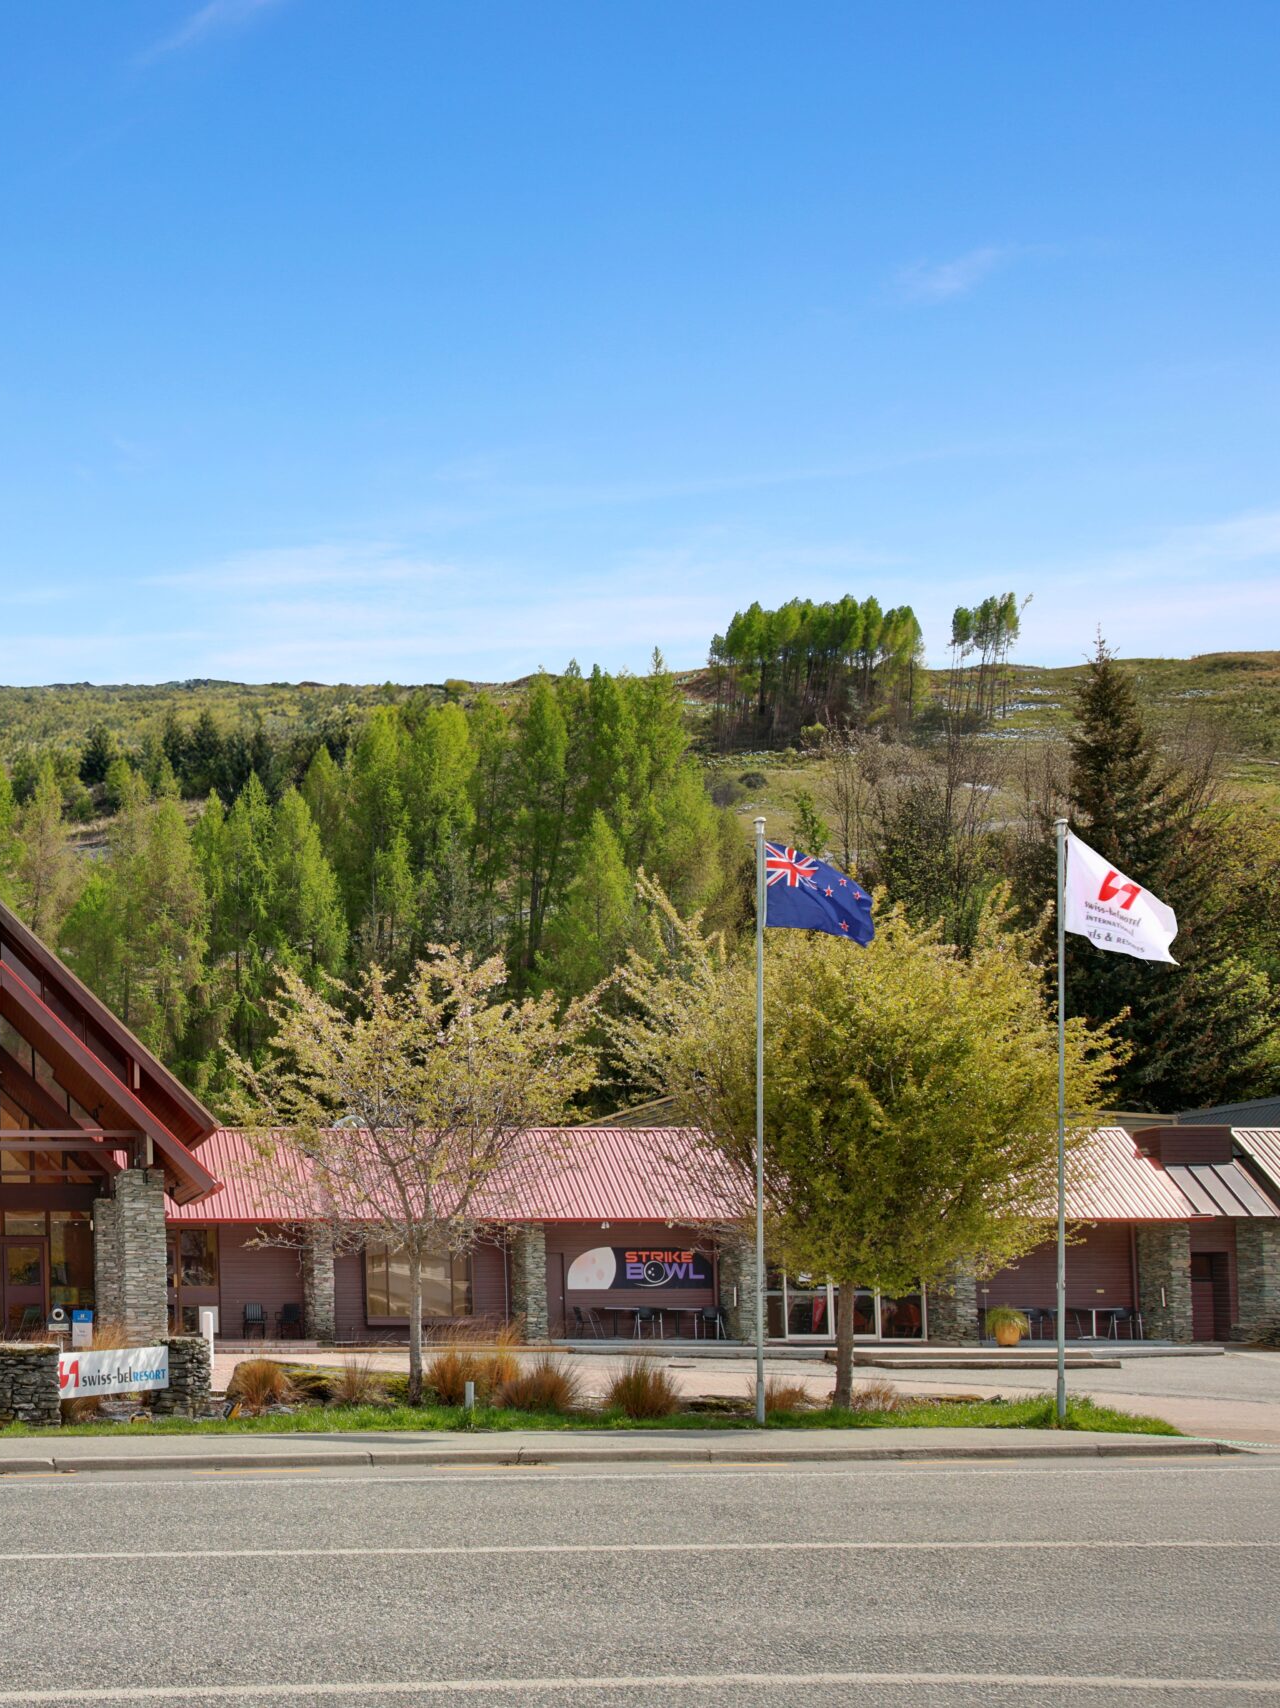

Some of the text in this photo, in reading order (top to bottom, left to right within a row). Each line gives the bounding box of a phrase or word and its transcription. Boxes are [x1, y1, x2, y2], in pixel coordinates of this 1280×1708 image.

[1104, 932, 1112, 942] &
[625, 1251, 694, 1263] STRIKE
[626, 1262, 705, 1282] BOWL
